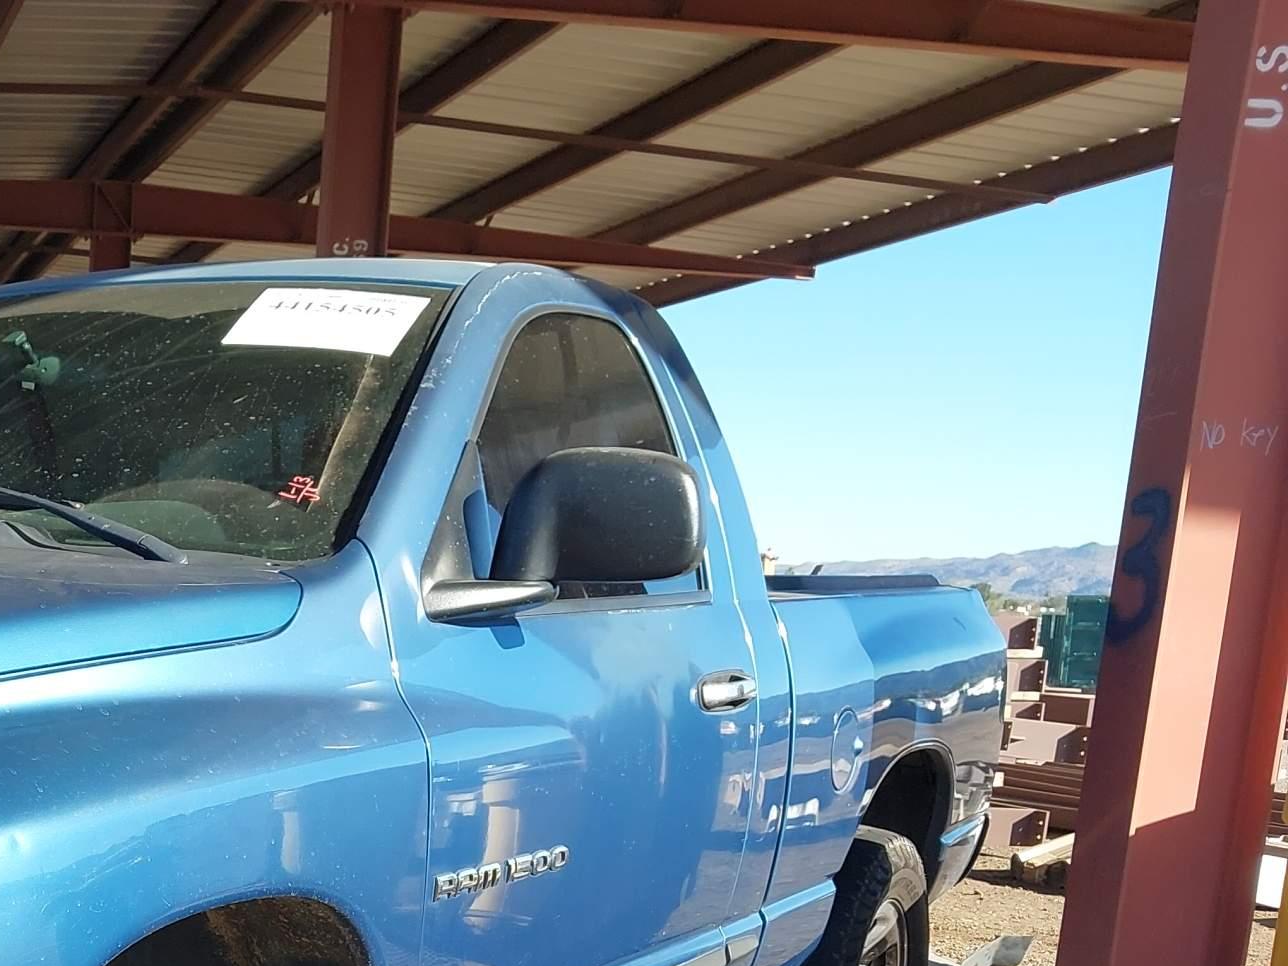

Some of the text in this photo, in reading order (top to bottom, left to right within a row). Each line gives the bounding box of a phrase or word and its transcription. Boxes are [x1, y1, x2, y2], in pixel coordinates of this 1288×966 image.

[1106, 487, 1171, 643] 3
[432, 844, 570, 902] RAM 1500
